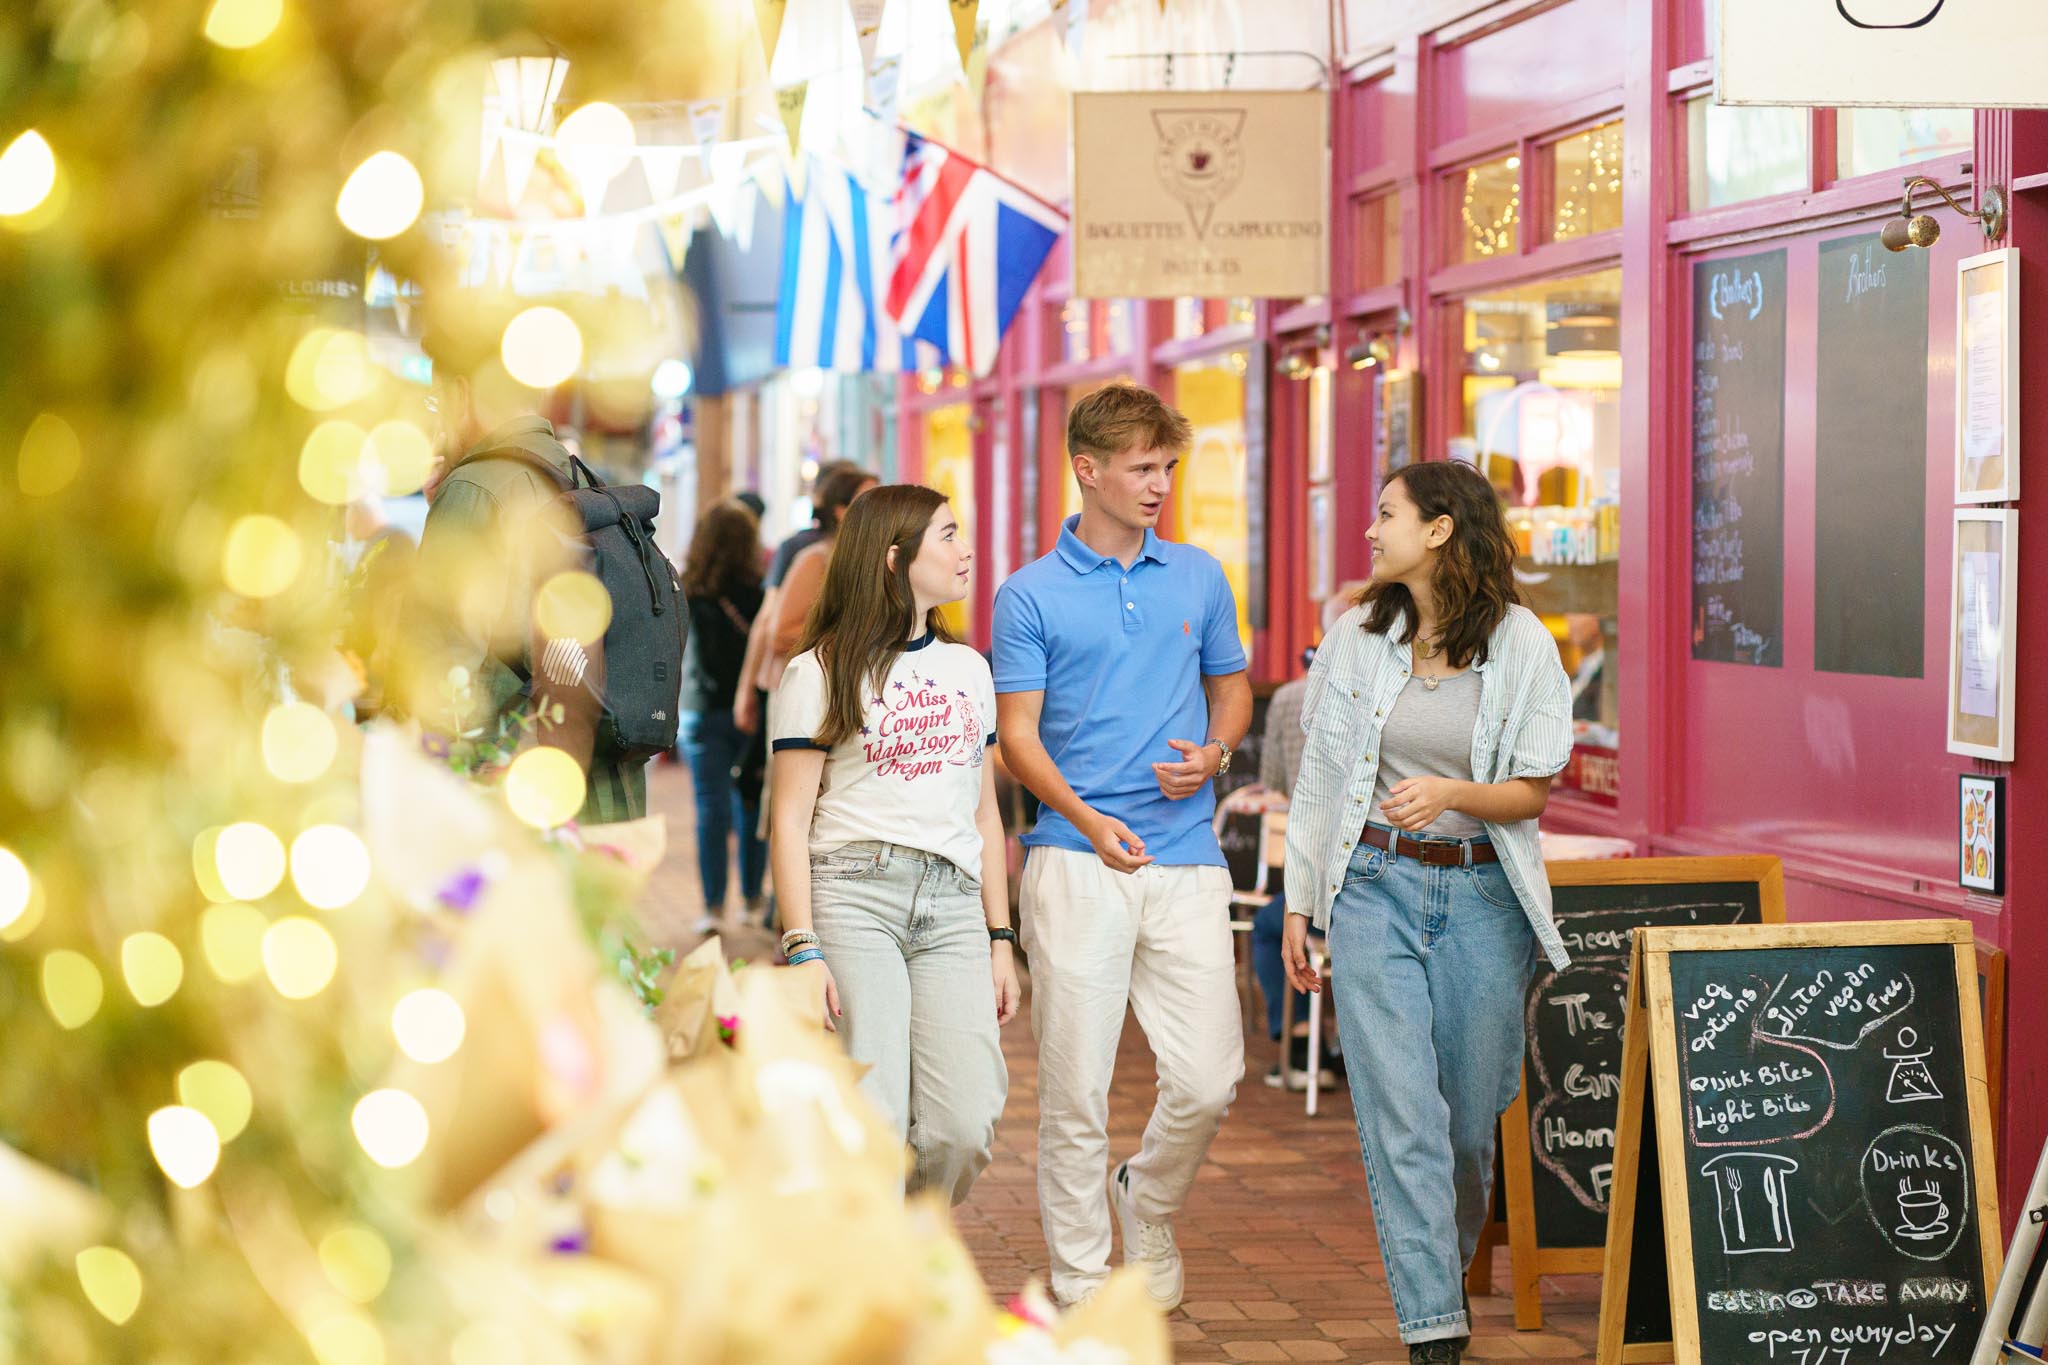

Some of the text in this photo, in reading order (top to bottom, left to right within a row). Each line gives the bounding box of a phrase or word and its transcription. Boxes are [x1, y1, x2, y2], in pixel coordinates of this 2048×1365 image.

[896, 690, 947, 711] Miss
[879, 705, 952, 737] Cowgirl
[863, 734, 961, 763] Idaho, 1997
[877, 758, 943, 781] Oregon
[1684, 983, 1733, 1020] veg
[1825, 963, 1875, 1016] vegan
[1548, 993, 1614, 1037] The
[1691, 988, 1757, 1052] options
[1758, 1061, 1813, 1086] Bites
[1695, 1093, 1811, 1134] Light Bites
[1544, 1117, 1616, 1152] Hom
[1872, 1144, 1957, 1172] Drinks
[1812, 1282, 1886, 1303] TAKE
[1901, 1283, 1968, 1303] AWAY
[1748, 1327, 1821, 1358] open
